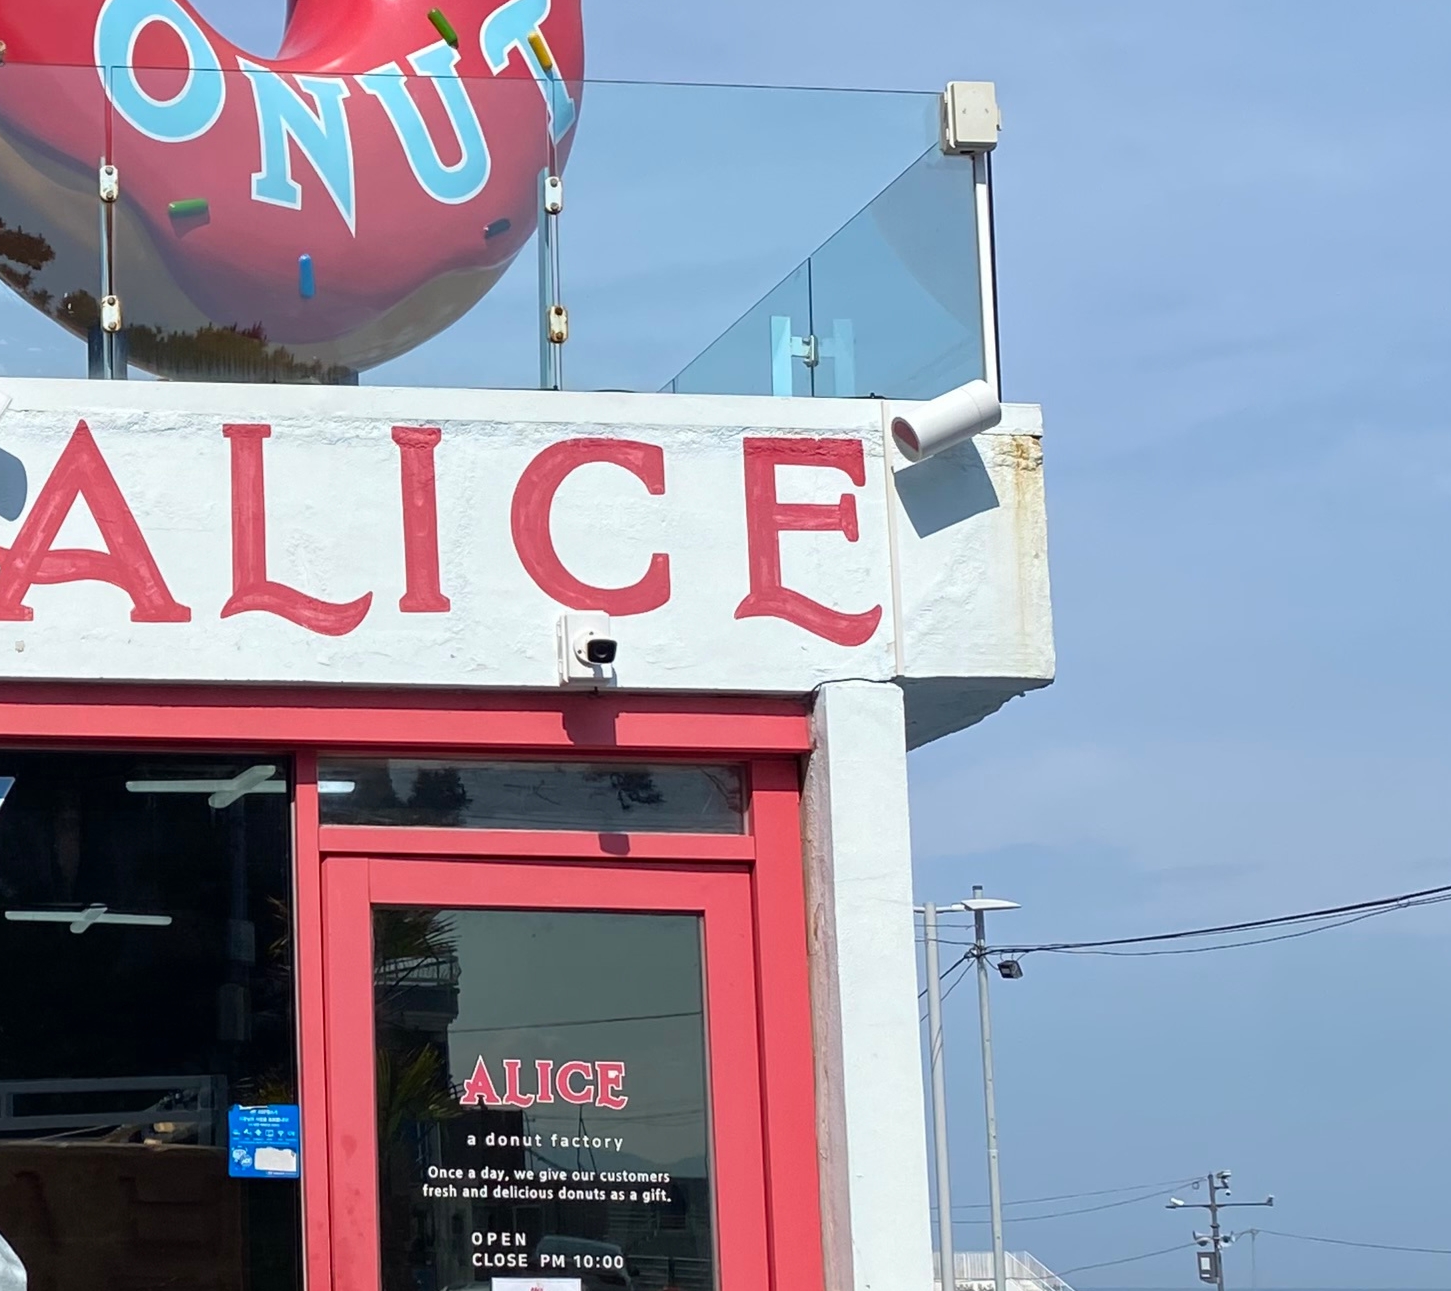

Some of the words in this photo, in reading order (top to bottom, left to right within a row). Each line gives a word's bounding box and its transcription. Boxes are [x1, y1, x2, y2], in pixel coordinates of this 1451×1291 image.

[459, 1054, 628, 1110] ALICE
[467, 1135, 476, 1146] a
[485, 1133, 542, 1147] donut
[550, 1133, 624, 1152] factory
[427, 1166, 463, 1179] Once
[468, 1169, 476, 1179] a
[481, 1166, 510, 1182] day,
[514, 1170, 534, 1180] we
[539, 1167, 567, 1184] give
[572, 1170, 595, 1181] our
[599, 1169, 670, 1183] customers
[422, 1184, 457, 1198] fresh
[462, 1185, 488, 1198] and
[493, 1185, 554, 1200] delicious
[558, 1186, 606, 1201] donuts
[610, 1190, 625, 1201] as
[629, 1190, 637, 1201] a
[642, 1188, 672, 1204] gift.
[471, 1231, 527, 1246] OPEN
[472, 1253, 528, 1268] CLOSE
[540, 1255, 566, 1269] PM
[573, 1254, 624, 1269] 10:00
